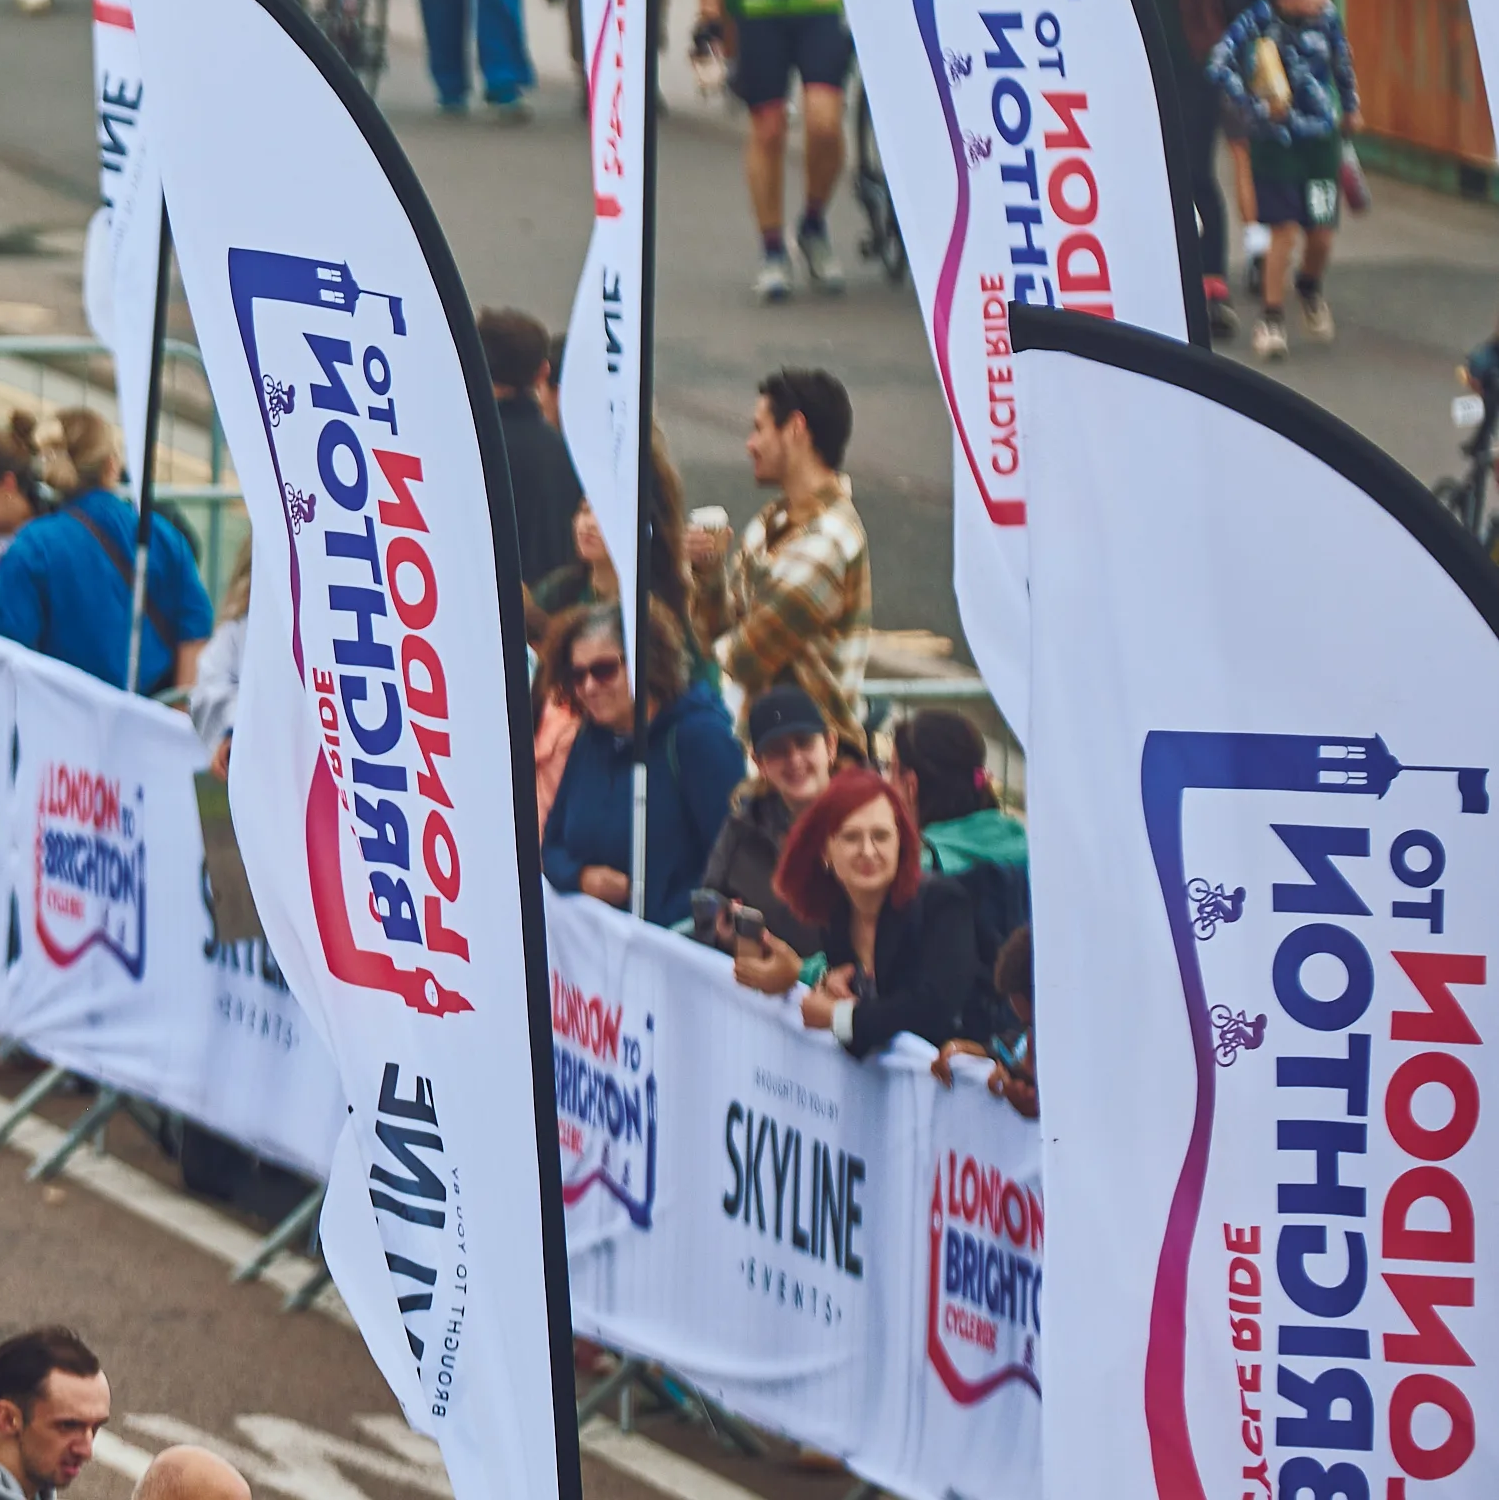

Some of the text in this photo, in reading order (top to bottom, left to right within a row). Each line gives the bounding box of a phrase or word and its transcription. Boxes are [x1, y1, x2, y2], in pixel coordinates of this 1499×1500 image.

[47, 760, 120, 831] LONDON
[44, 825, 136, 903] BRIGHTON
[552, 968, 641, 1072] LONDON TO
[723, 1099, 867, 1281] SKYLINE
[948, 1147, 1044, 1256] LONDON
[747, 1256, 834, 1328] EVENTS
[945, 1226, 1043, 1337] BRIGHT
